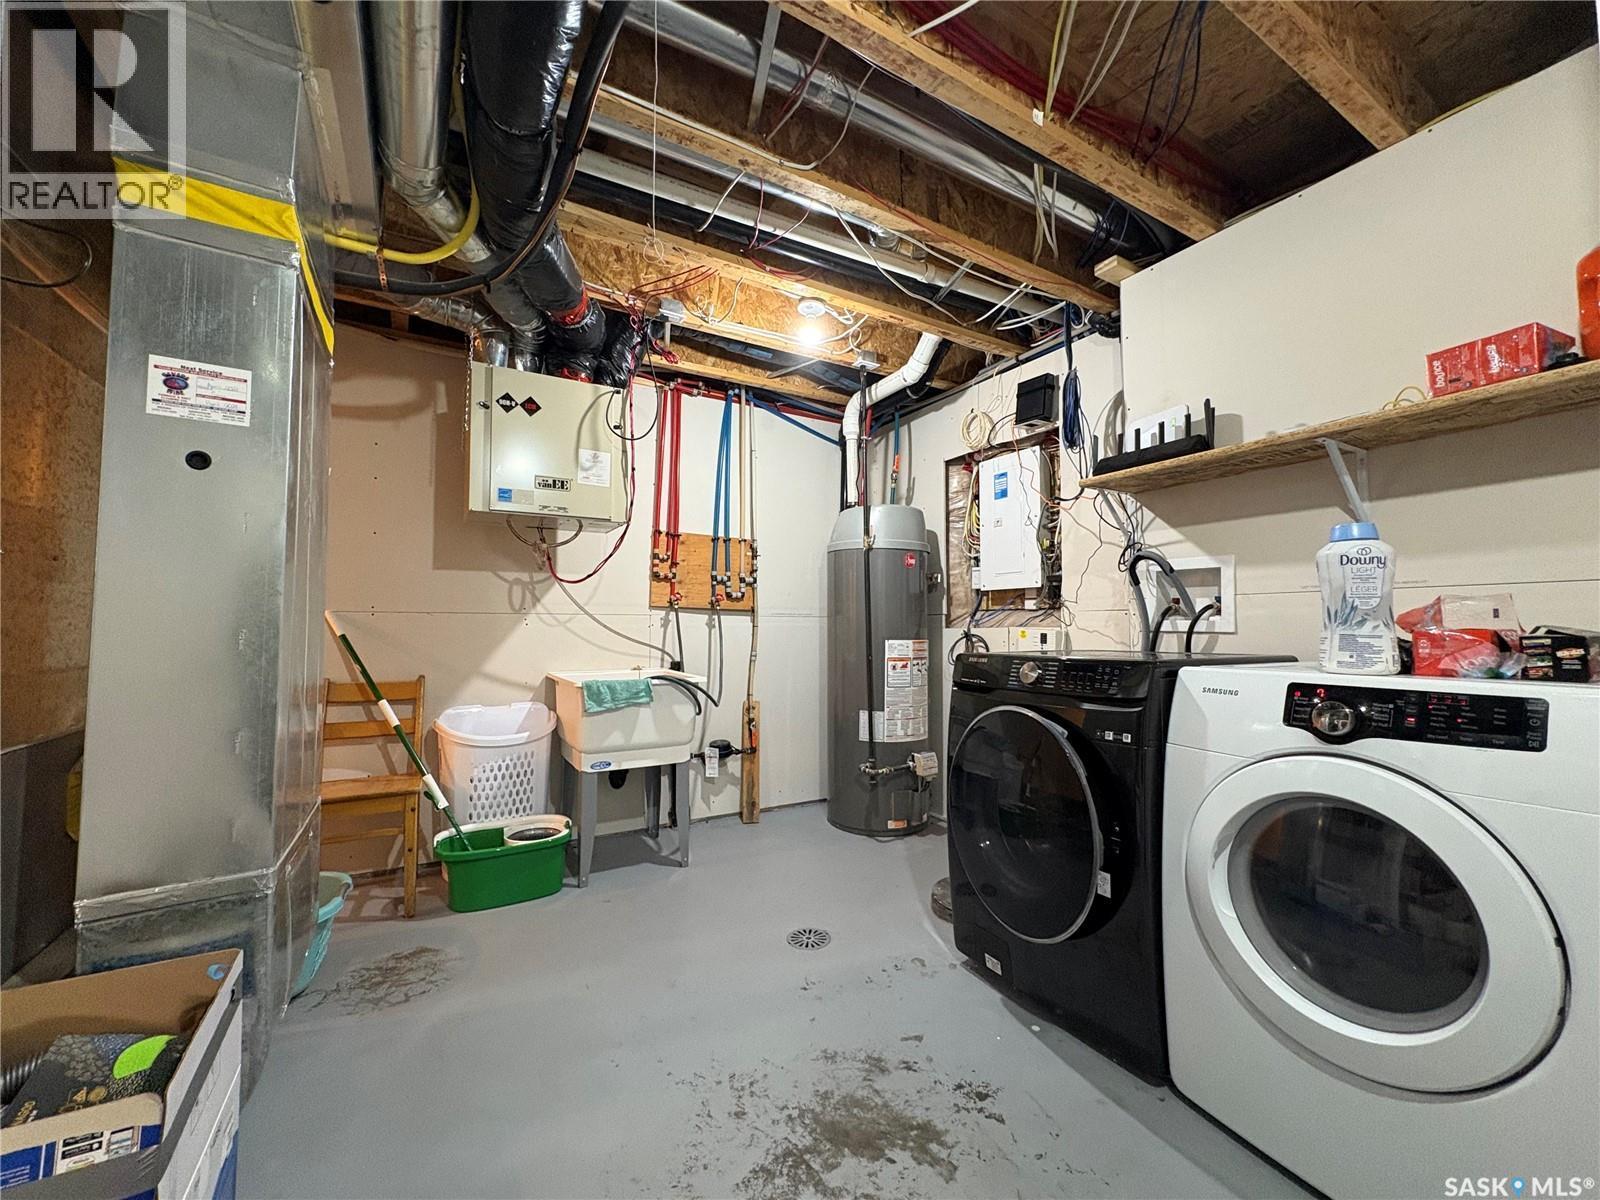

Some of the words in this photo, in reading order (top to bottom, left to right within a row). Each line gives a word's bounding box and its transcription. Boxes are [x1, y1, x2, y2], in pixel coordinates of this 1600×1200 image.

[537, 479, 569, 491] vänEE
[1340, 554, 1387, 569] Downy
[1351, 566, 1377, 575] LIGHT
[1201, 686, 1240, 697] SAMSUNG
